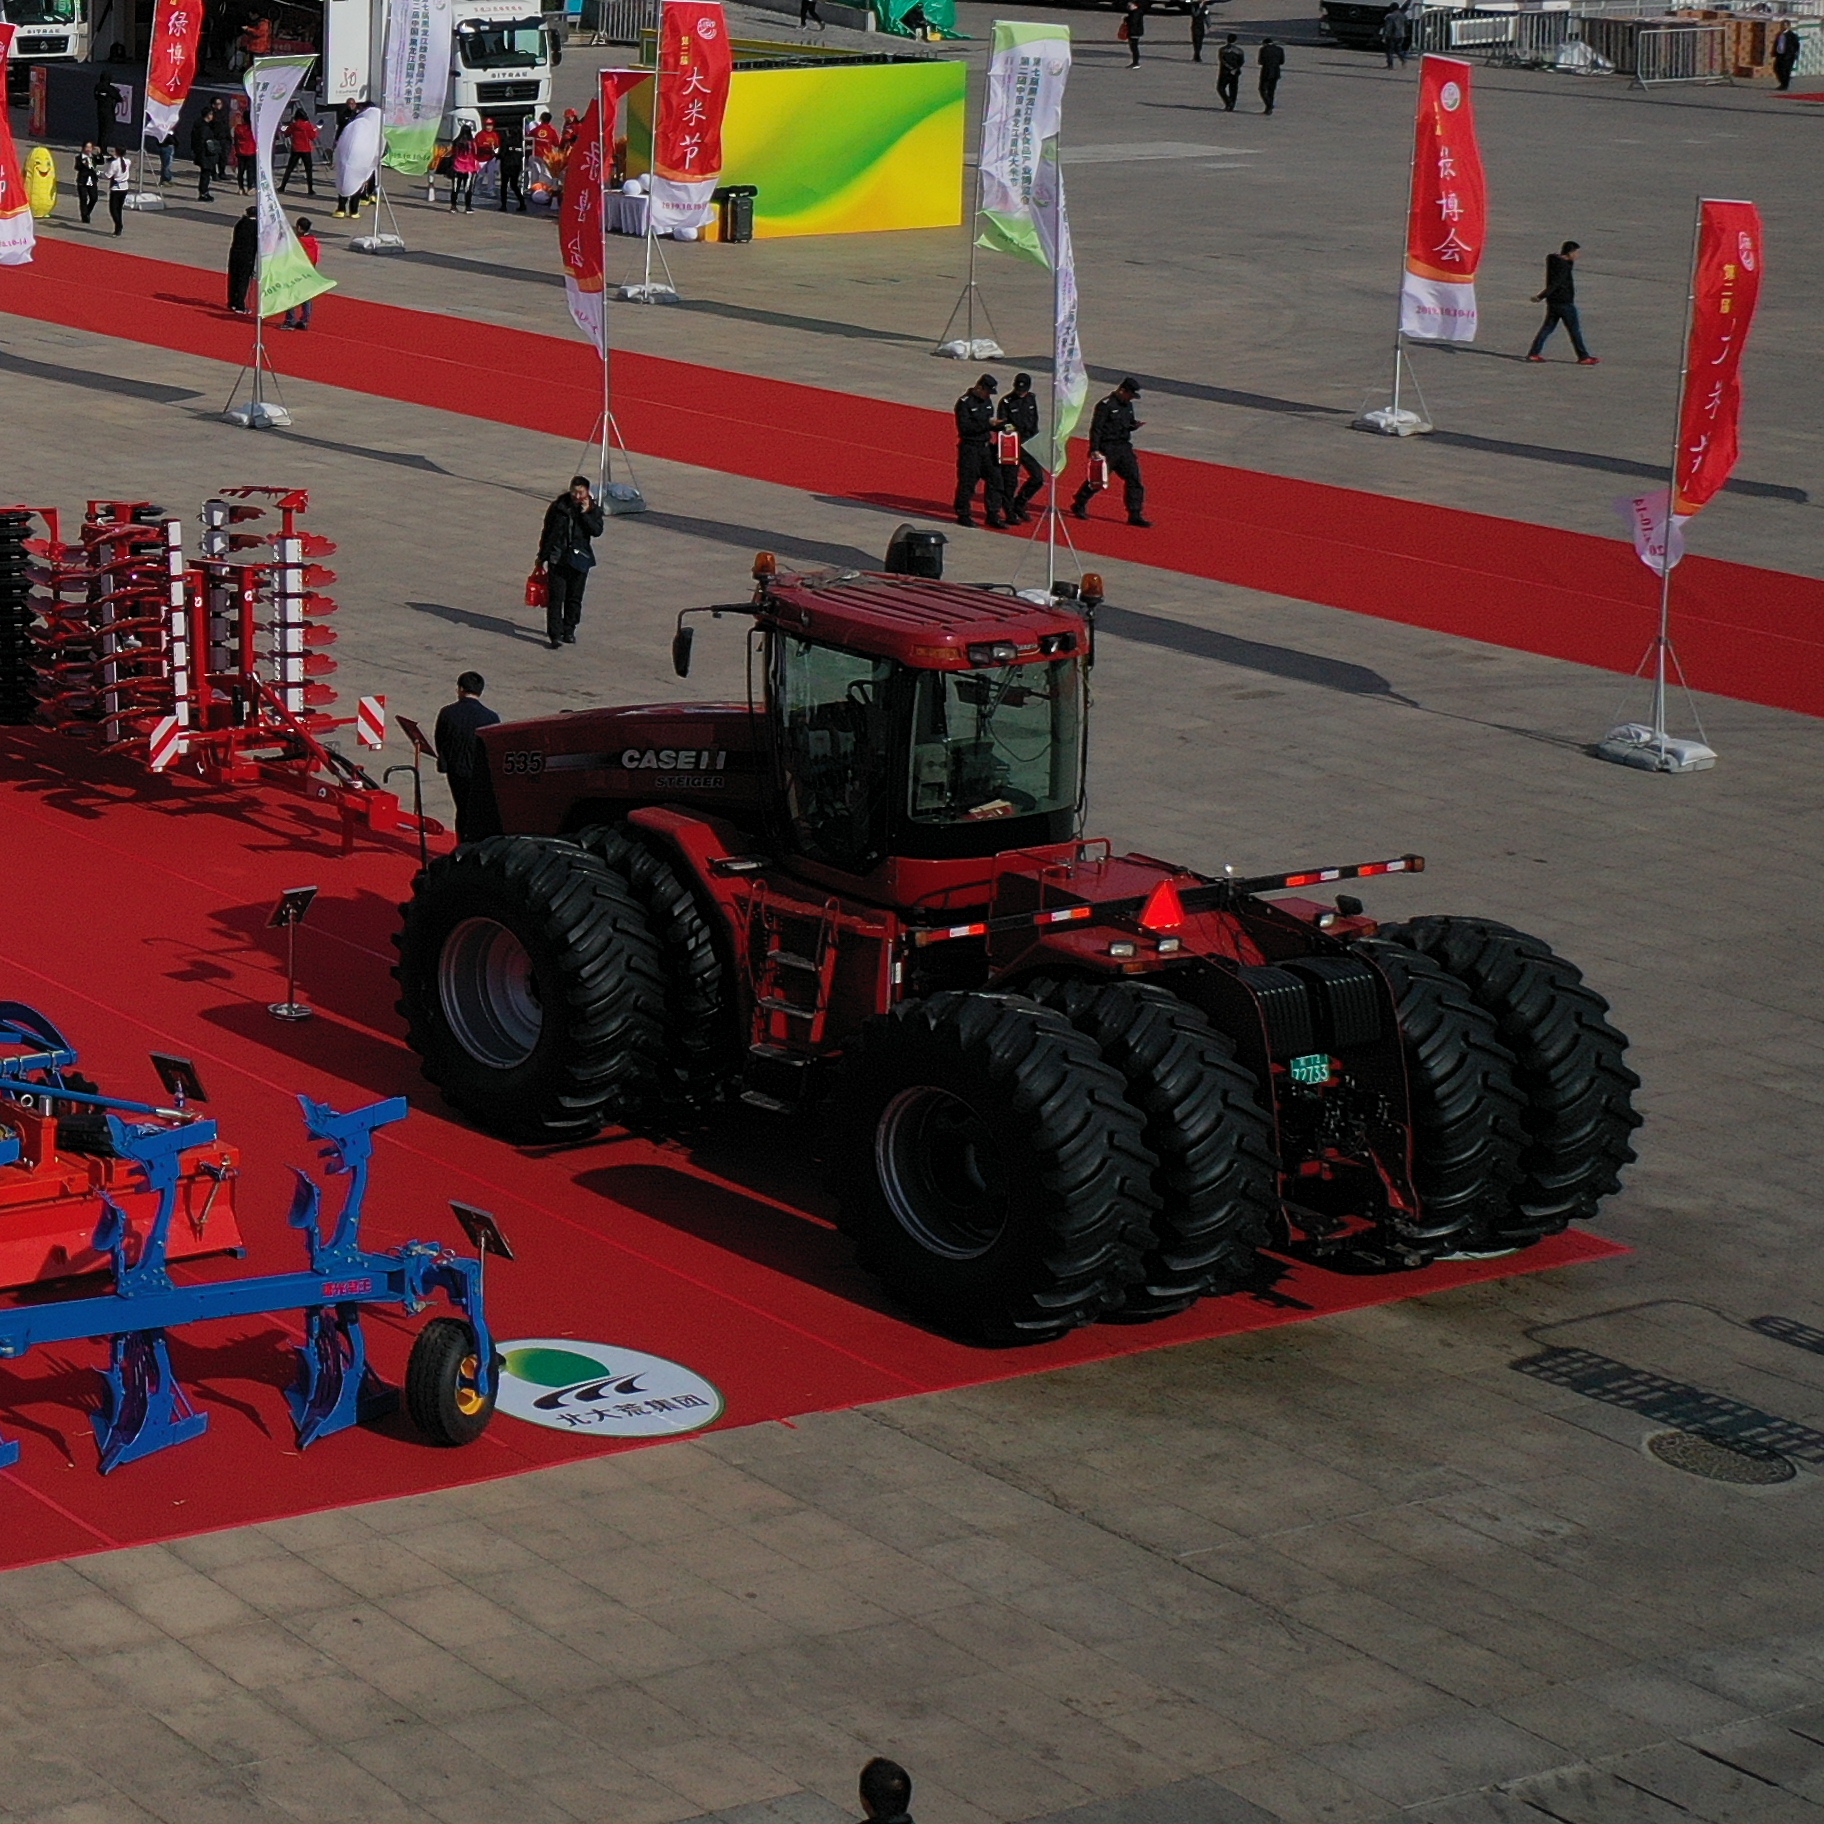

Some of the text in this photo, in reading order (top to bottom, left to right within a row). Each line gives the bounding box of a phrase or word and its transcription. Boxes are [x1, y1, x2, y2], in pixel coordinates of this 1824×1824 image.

[166, 10, 189, 92] 绿博会
[680, 65, 712, 170] 大米节
[503, 751, 542, 775] 535
[621, 749, 695, 771] CASE
[655, 776, 724, 789] STEIGER
[557, 1393, 708, 1429] 北大荒集团
